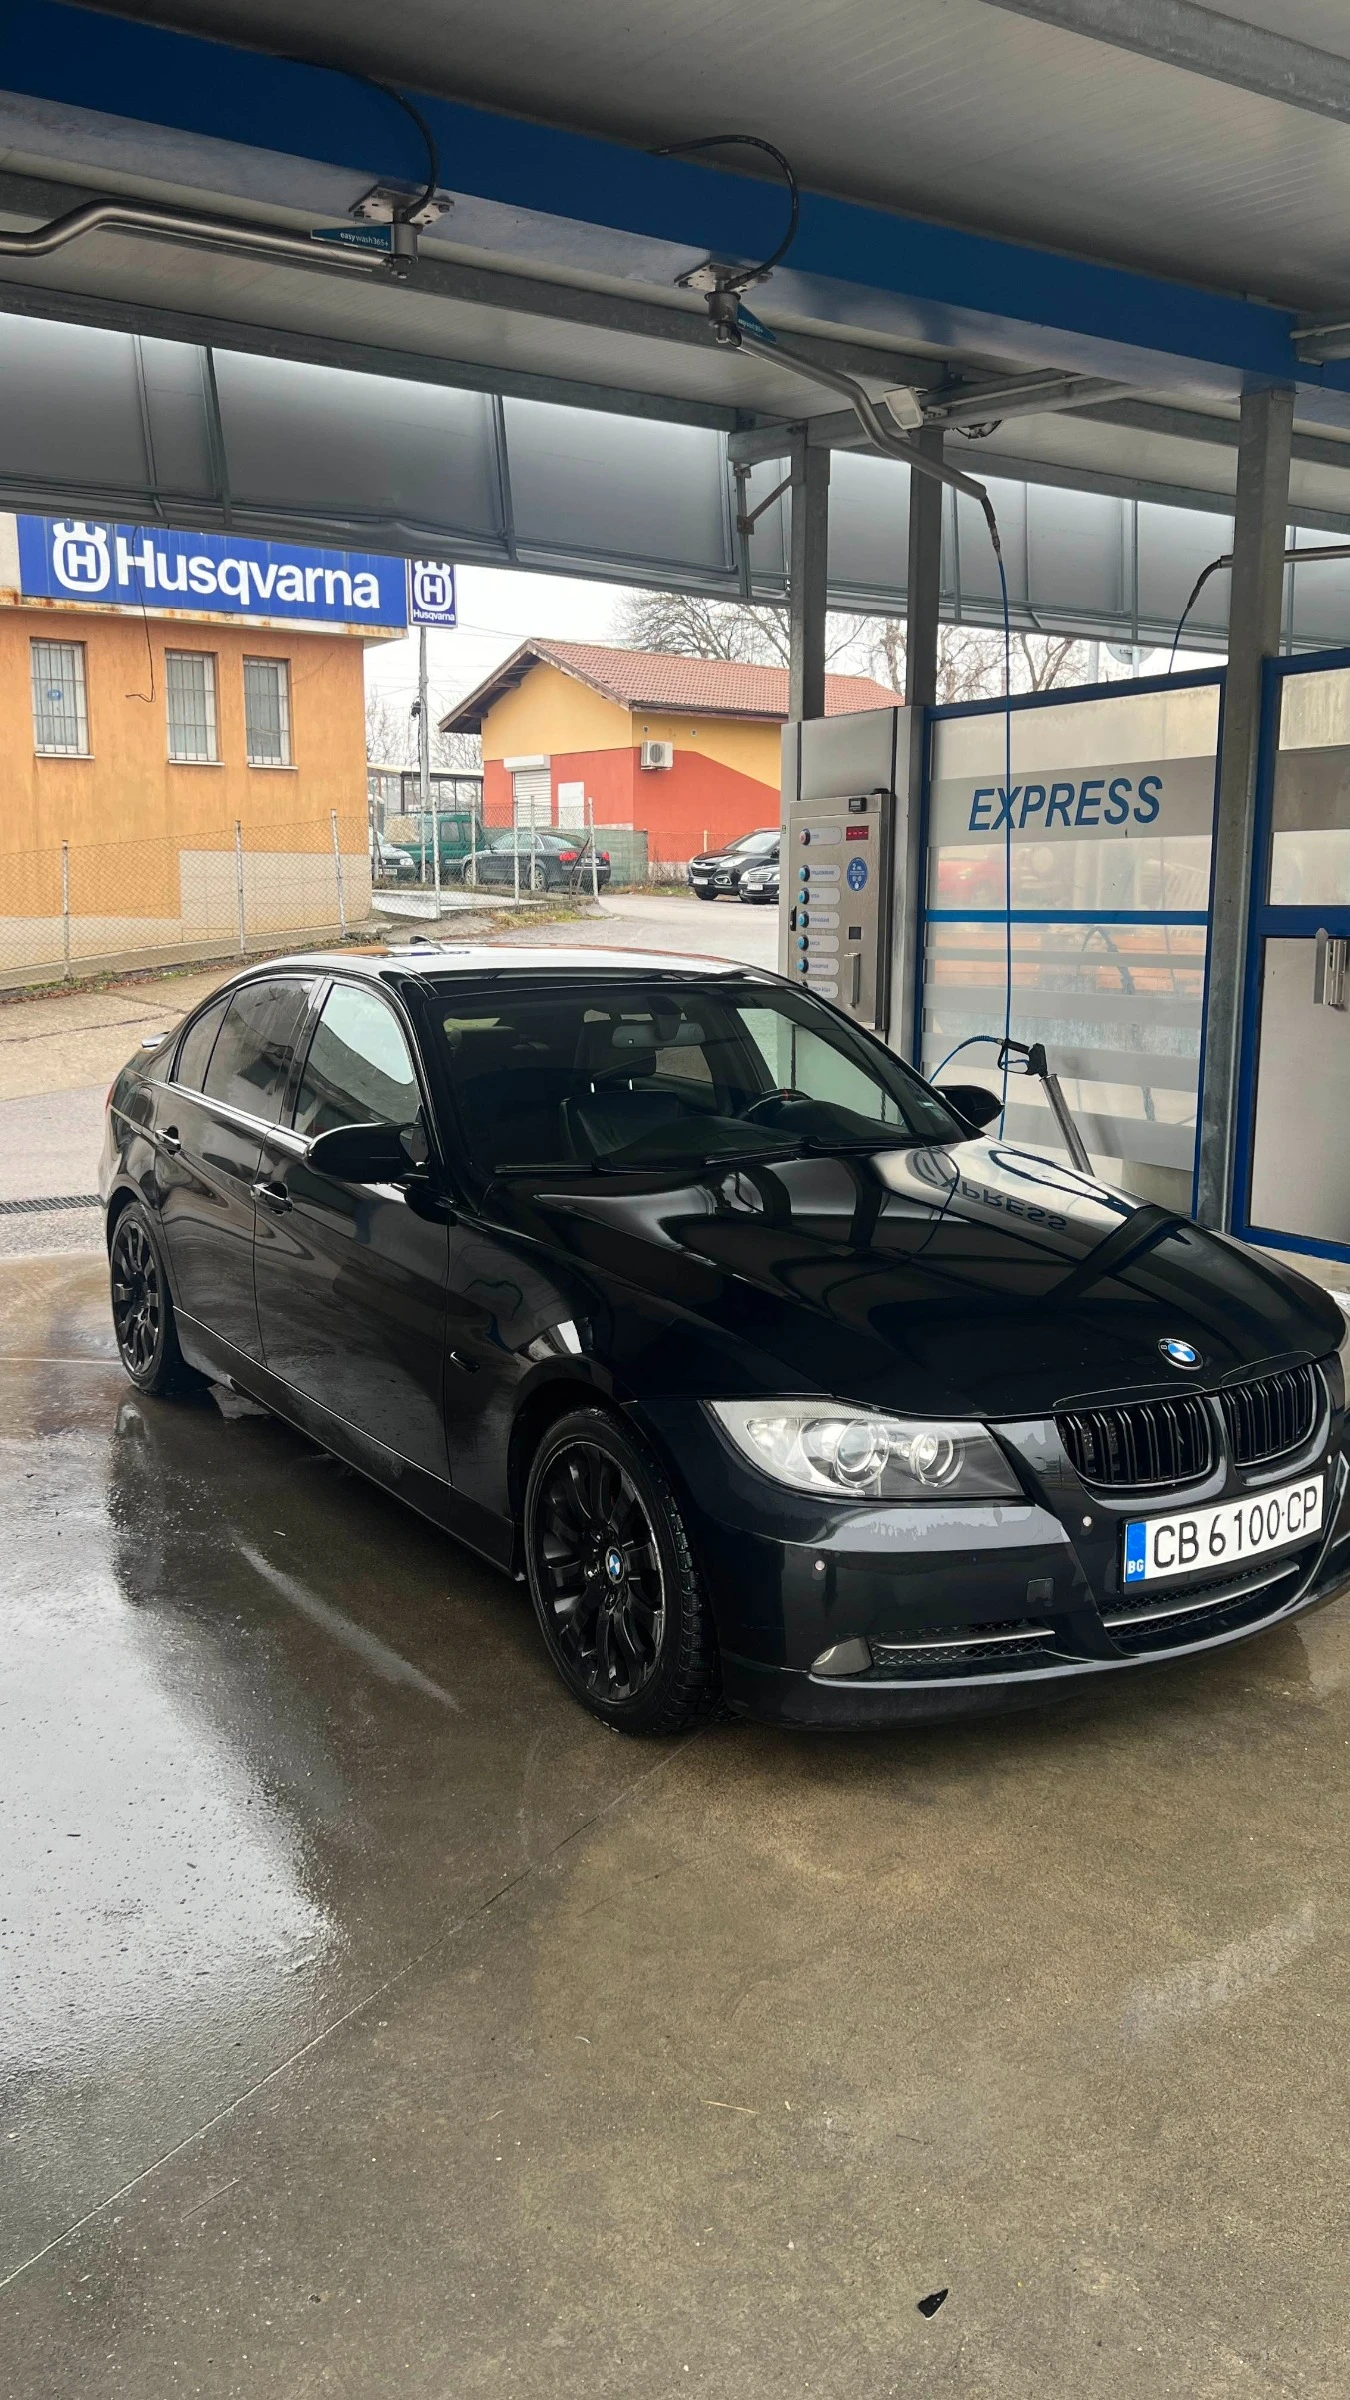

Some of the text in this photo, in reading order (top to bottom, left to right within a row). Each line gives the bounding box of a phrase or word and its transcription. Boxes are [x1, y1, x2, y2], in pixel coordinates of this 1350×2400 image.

[340, 232, 389, 247] easywash365+
[116, 537, 380, 609] Husqvarna
[413, 609, 455, 621] Husqvarna
[968, 775, 1163, 832] EXPRESS
[1127, 1559, 1144, 1575] BG
